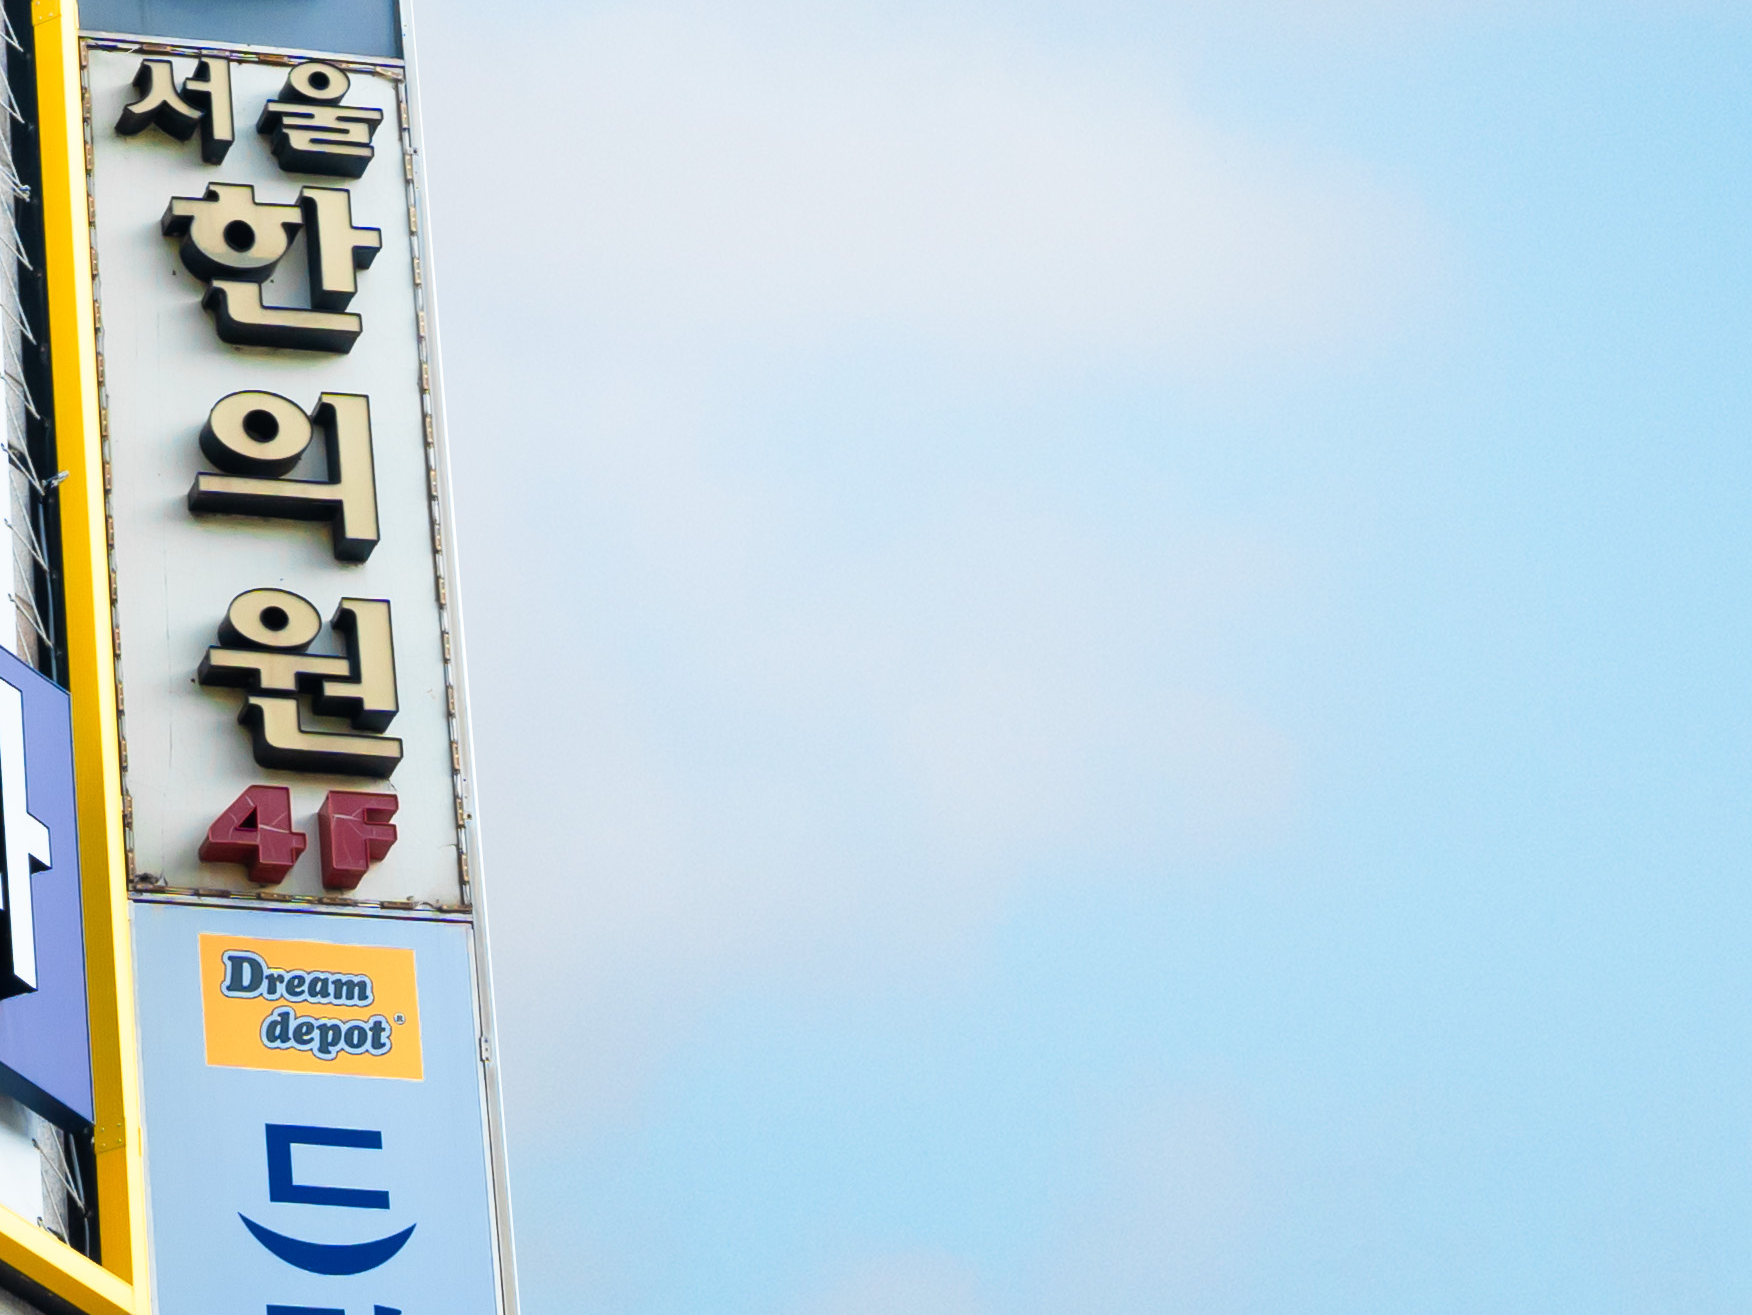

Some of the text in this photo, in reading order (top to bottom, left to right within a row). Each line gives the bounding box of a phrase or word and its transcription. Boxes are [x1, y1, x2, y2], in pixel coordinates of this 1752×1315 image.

[115, 57, 384, 178] 서울
[162, 180, 404, 778] 한의원
[198, 784, 401, 890] 4F
[223, 952, 372, 1005] Dream
[264, 1009, 392, 1057] depot
